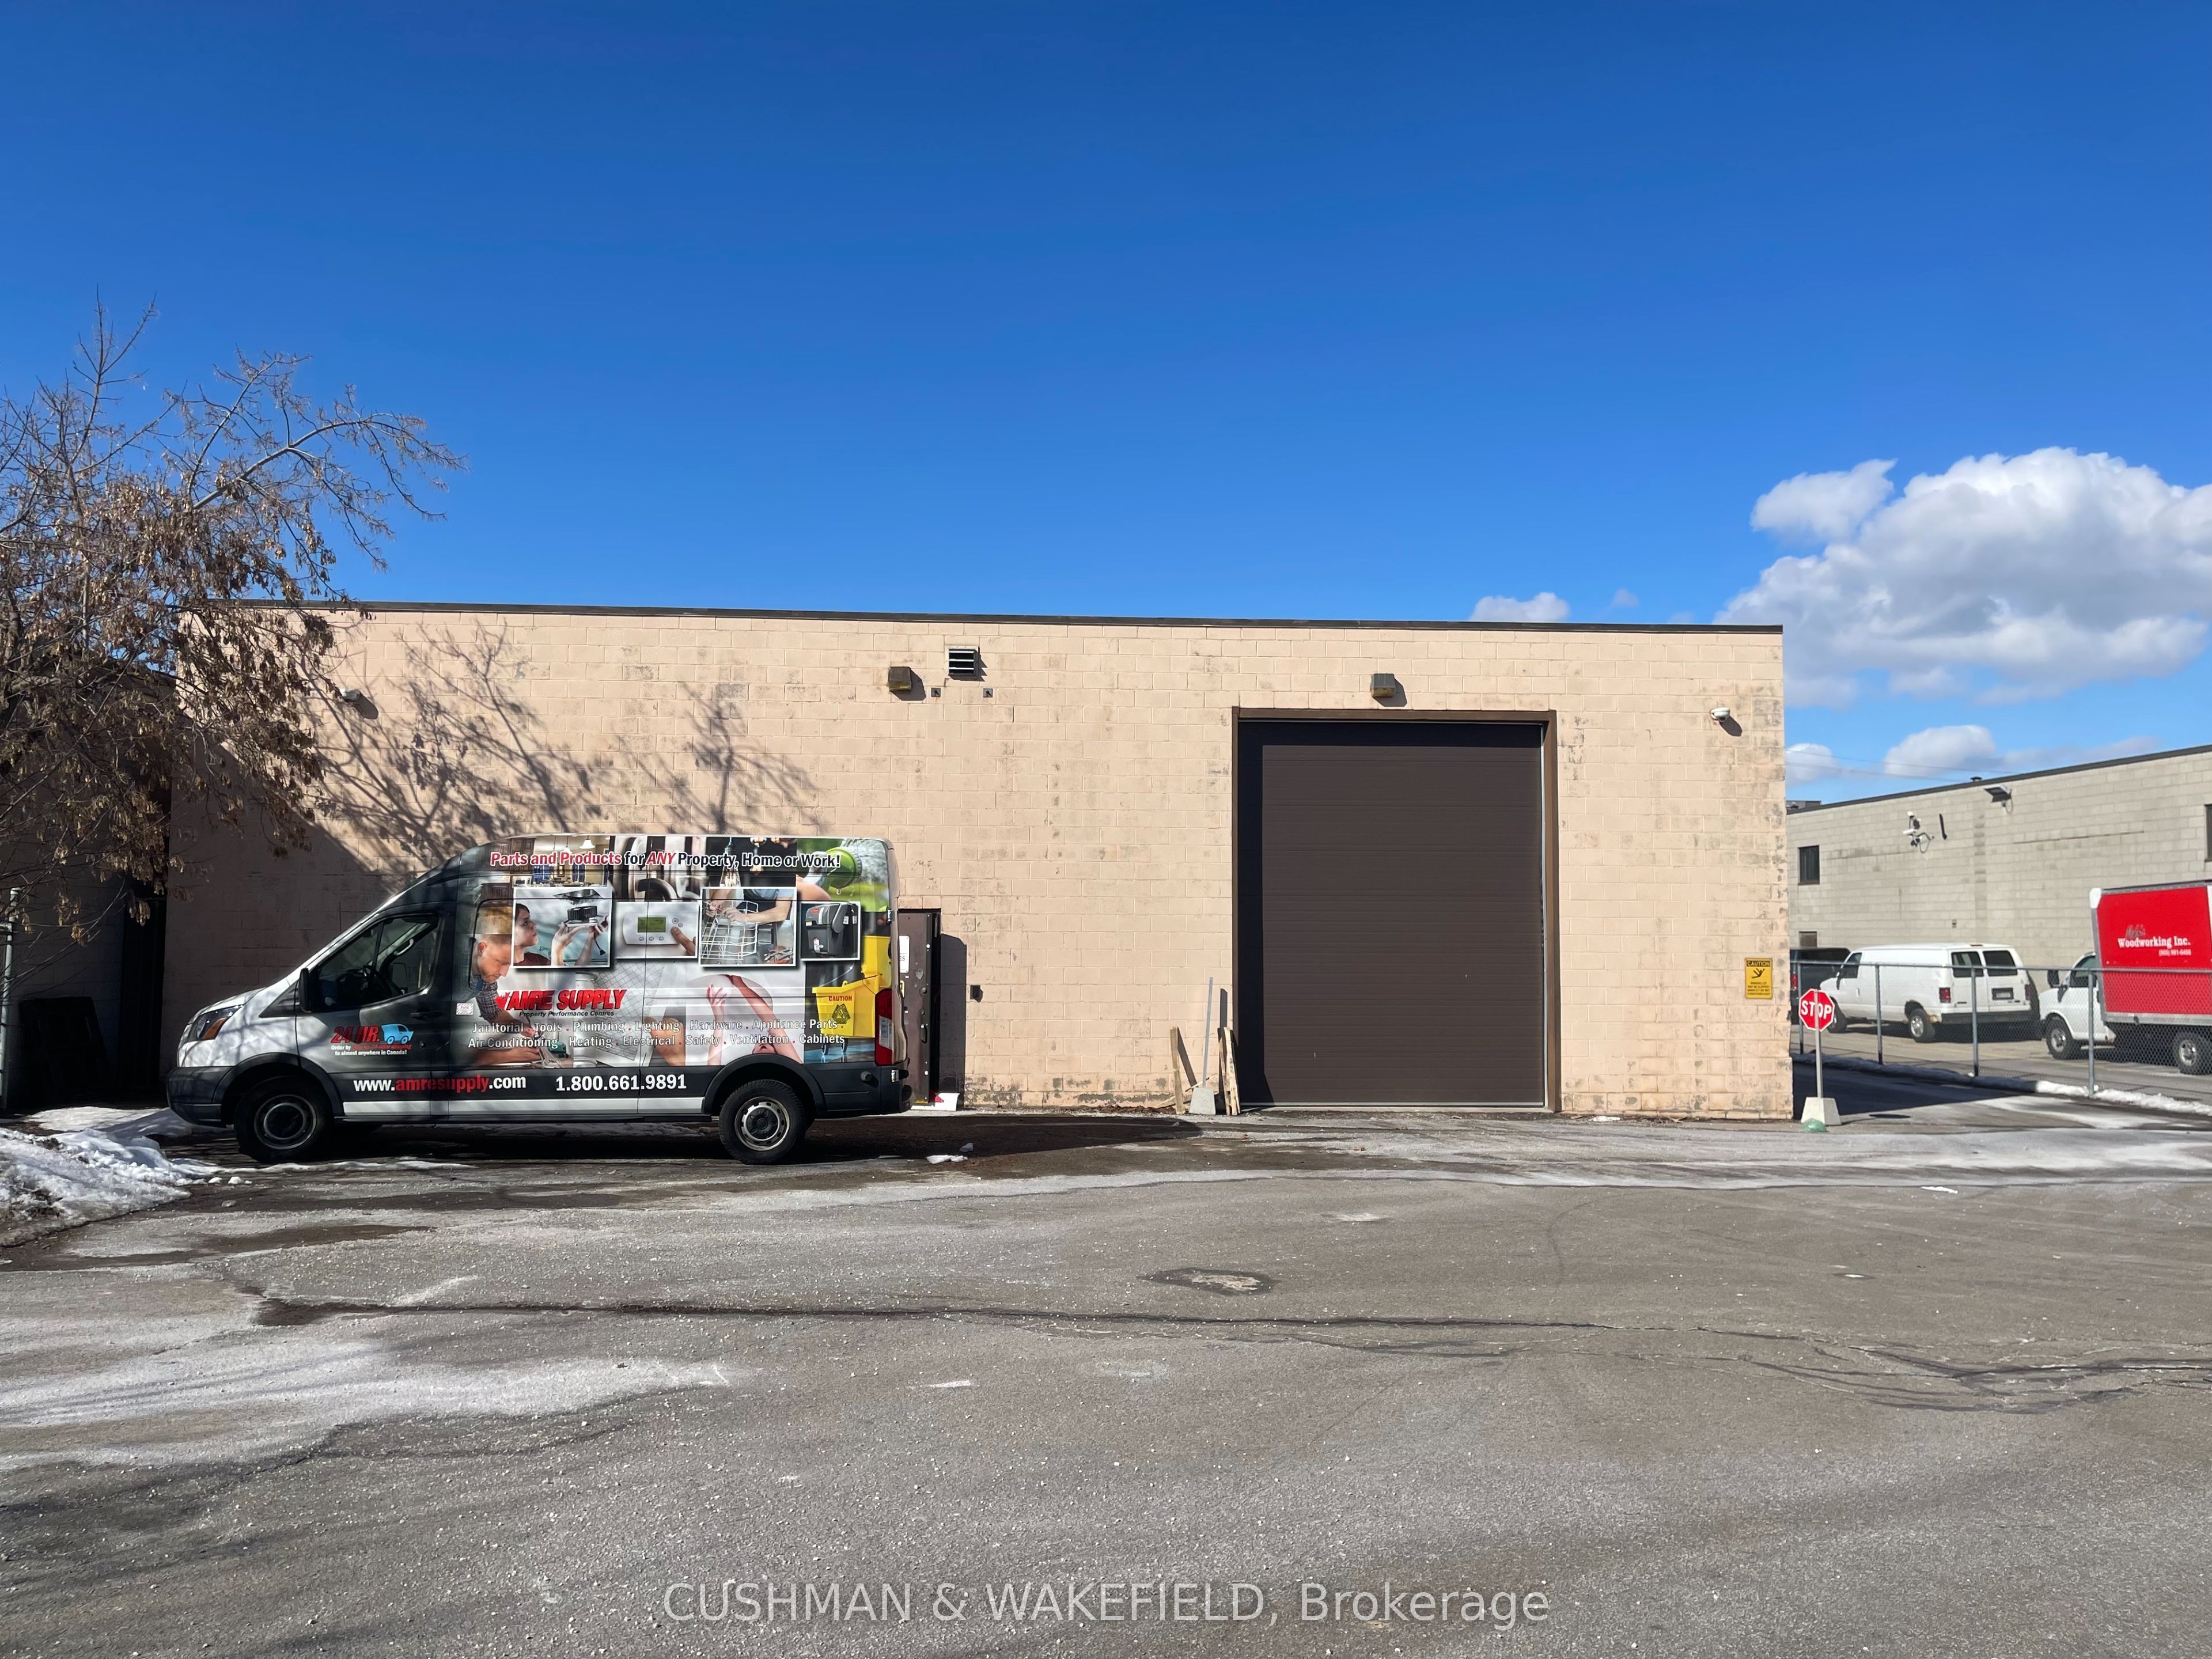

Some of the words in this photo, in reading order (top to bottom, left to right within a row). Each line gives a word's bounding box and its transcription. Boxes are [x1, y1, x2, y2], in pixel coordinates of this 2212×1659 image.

[491, 852, 527, 865] Parts
[530, 852, 556, 865] and
[560, 851, 622, 865] Products
[624, 851, 645, 865] for
[646, 851, 676, 865] ANY
[677, 852, 738, 868] Property,
[742, 852, 781, 867] Home
[783, 855, 799, 867] or
[801, 853, 841, 868] Work!
[2118, 936, 2172, 949] Woodworking
[2173, 935, 2191, 946] Inc.
[506, 990, 555, 1010] AMRE
[556, 989, 627, 1010] SUPPLY
[1801, 1000, 1832, 1020] STOP
[331, 1025, 354, 1043] 24
[472, 1023, 524, 1033] Janitorial
[534, 1022, 562, 1032] Tools
[573, 1022, 625, 1033] Plumbing
[635, 1021, 680, 1032] Lighting
[690, 1020, 743, 1030] Hardware
[752, 1019, 806, 1031] Appliance
[809, 1019, 838, 1029] Parts
[468, 1037, 484, 1048] Air
[487, 1037, 558, 1049] Conditioning
[569, 1036, 612, 1048] Heating
[623, 1035, 675, 1046] Electrical
[685, 1035, 721, 1046] Safety
[730, 1034, 789, 1044] Ventilation
[800, 1033, 845, 1044] Cabinets
[353, 1074, 527, 1093] www.amresupply.com
[556, 1074, 687, 1092] 1.800.661.9891
